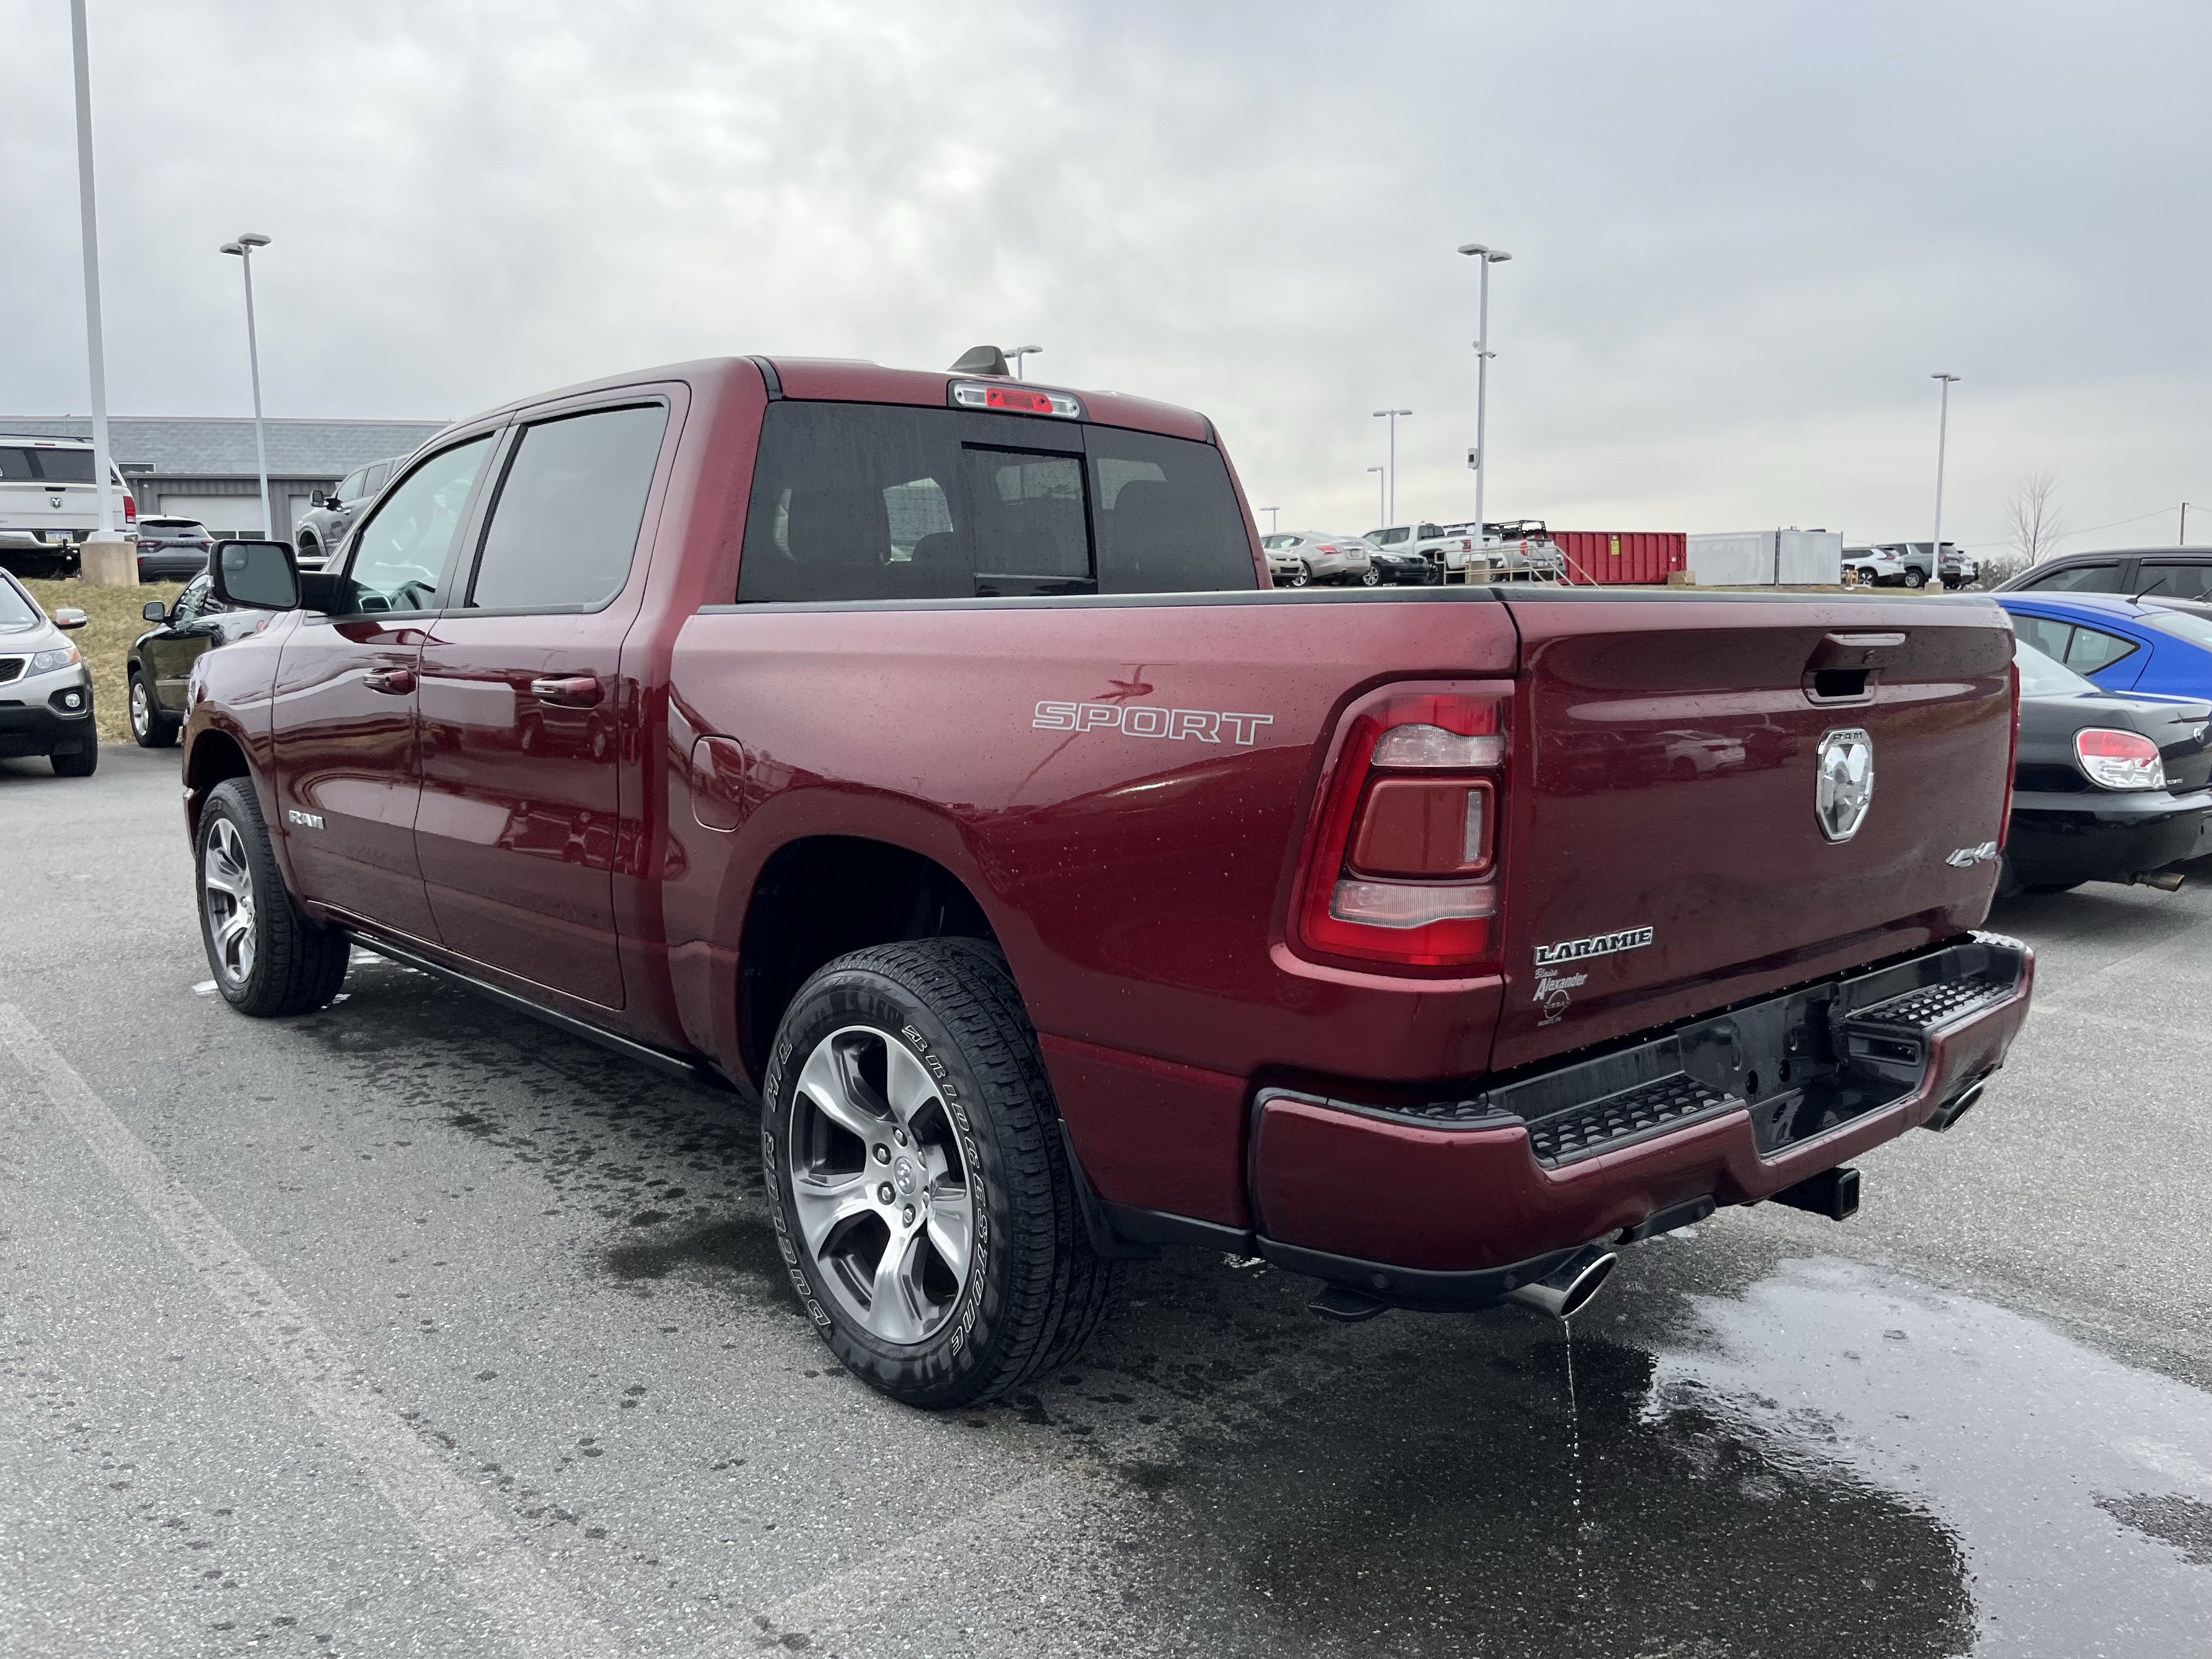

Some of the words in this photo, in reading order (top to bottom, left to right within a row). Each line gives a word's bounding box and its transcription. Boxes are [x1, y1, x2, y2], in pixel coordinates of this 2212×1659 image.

[1032, 701, 1274, 746] SPORT
[1833, 732, 1862, 740] RAM
[289, 810, 324, 830] RAM
[1533, 926, 1653, 966] LARAMIE
[1532, 972, 1588, 1002] Alexander
[1543, 999, 1571, 1009] NISSAN
[901, 1024, 988, 1356] BRIDGESTONE
[764, 1131, 832, 1327] DUELER
